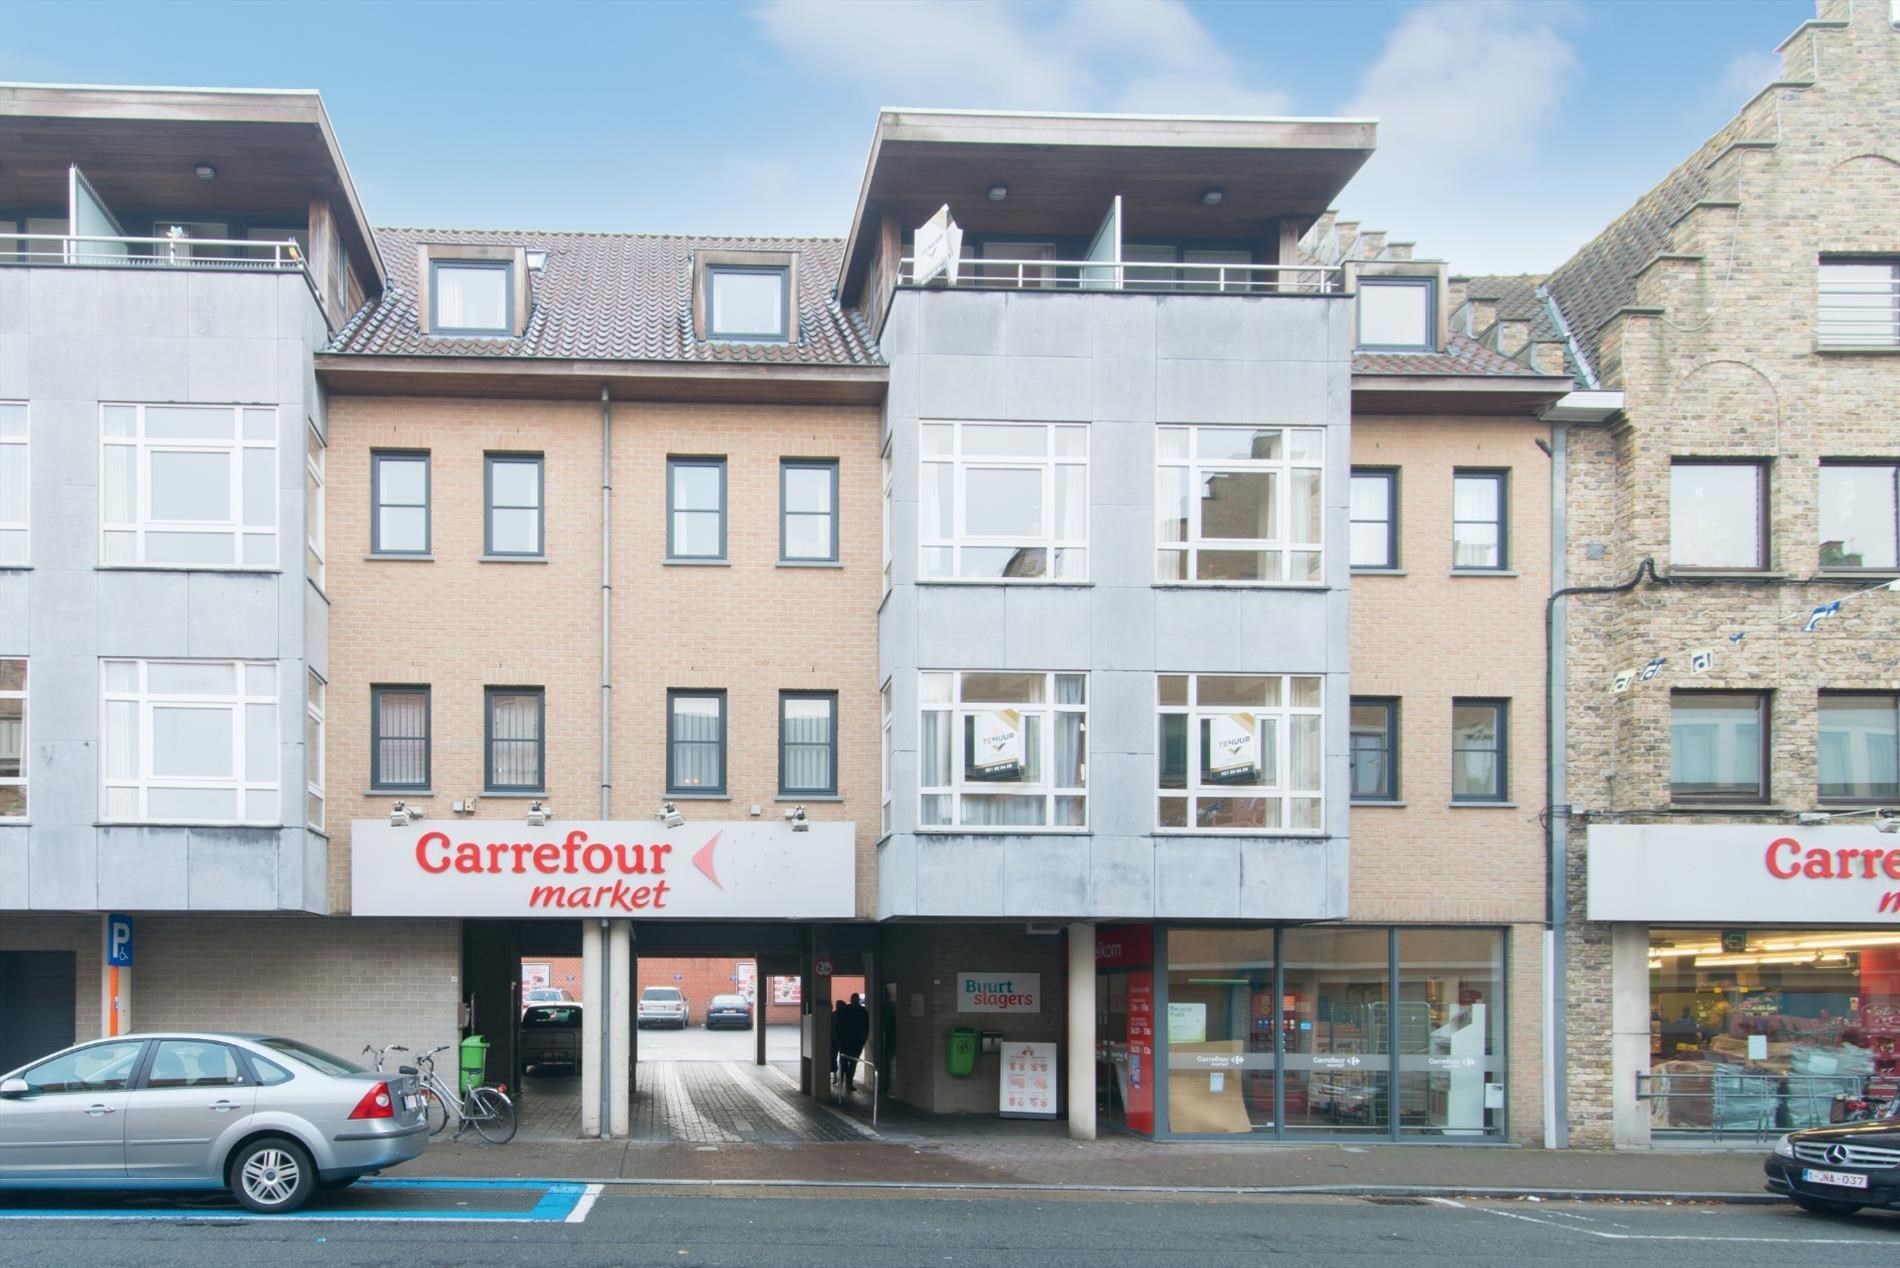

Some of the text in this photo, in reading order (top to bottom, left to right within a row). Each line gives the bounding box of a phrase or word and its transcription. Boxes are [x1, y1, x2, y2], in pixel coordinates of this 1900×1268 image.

[416, 831, 672, 874] Carrefour
[529, 879, 671, 913] market
[113, 922, 130, 958] P
[965, 980, 1014, 993] Buurt
[974, 991, 1033, 1009] slagers
